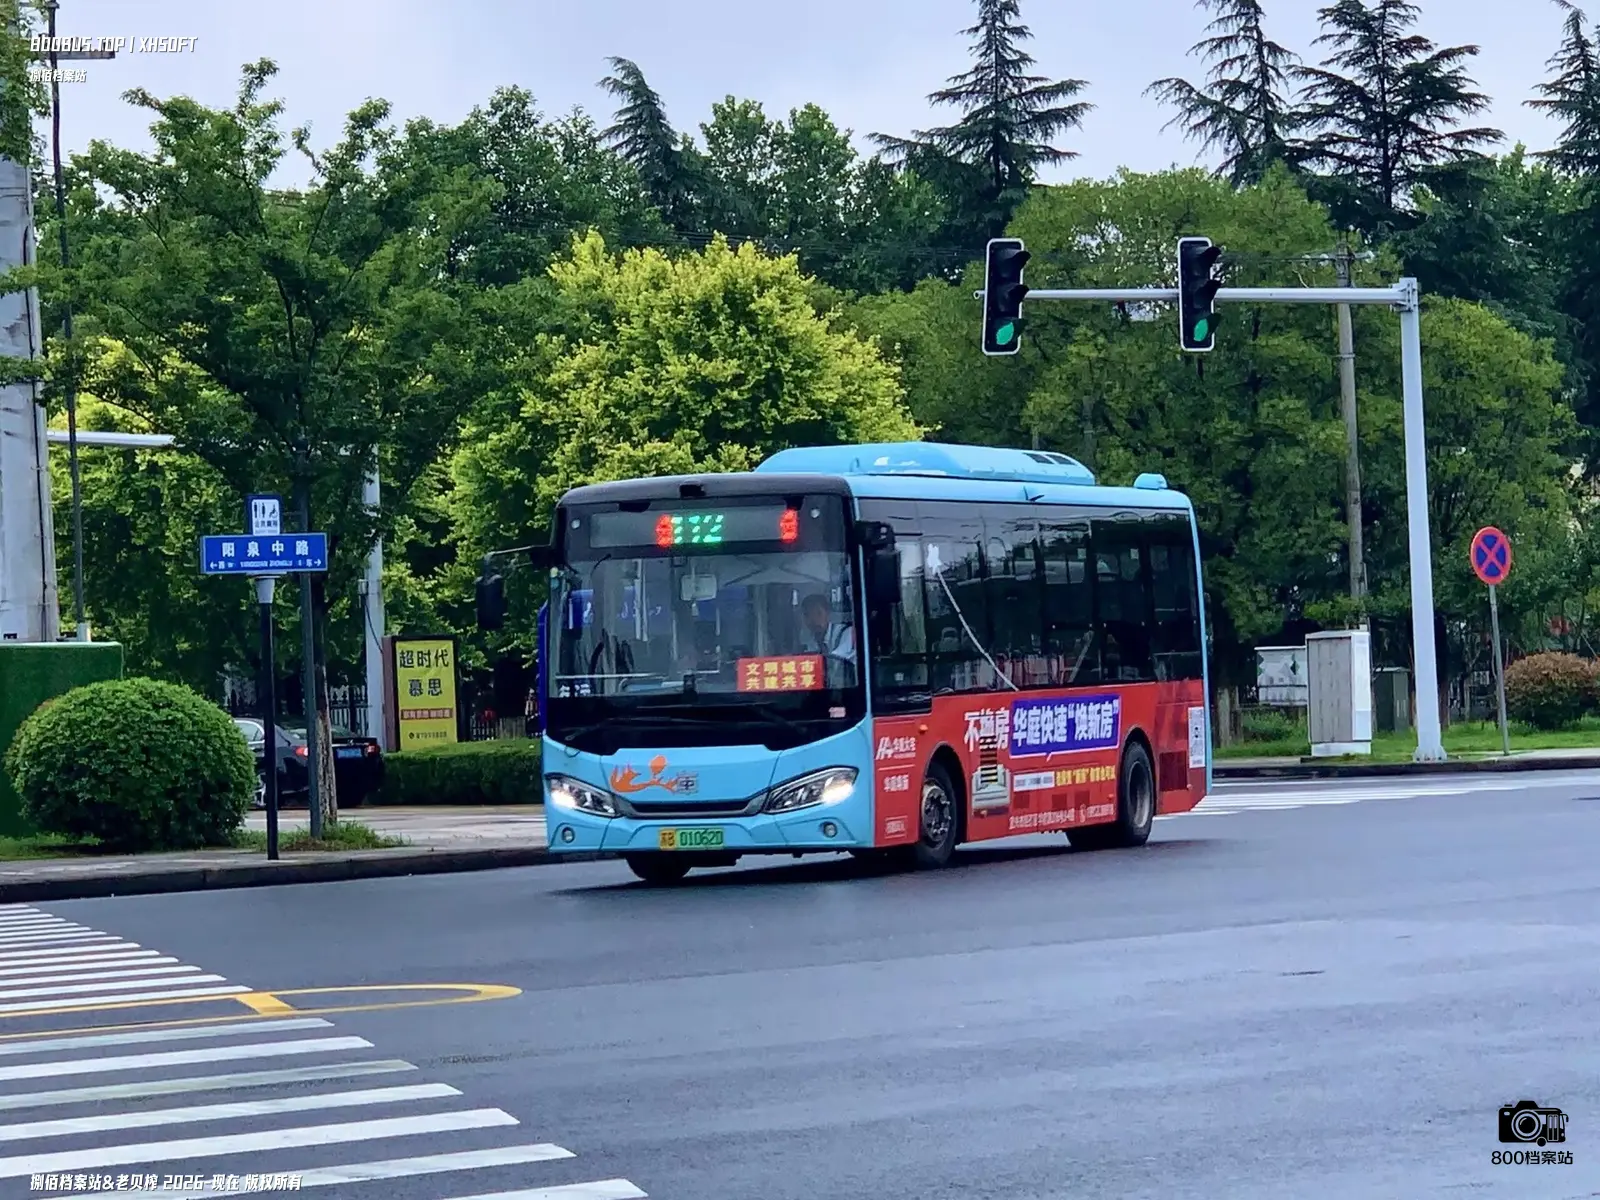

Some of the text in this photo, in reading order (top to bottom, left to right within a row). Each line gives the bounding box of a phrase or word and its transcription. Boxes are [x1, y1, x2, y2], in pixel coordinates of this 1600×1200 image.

[221, 540, 309, 558] 阳泉中路
[400, 649, 449, 668] 超时代
[746, 660, 816, 676] 文明城市
